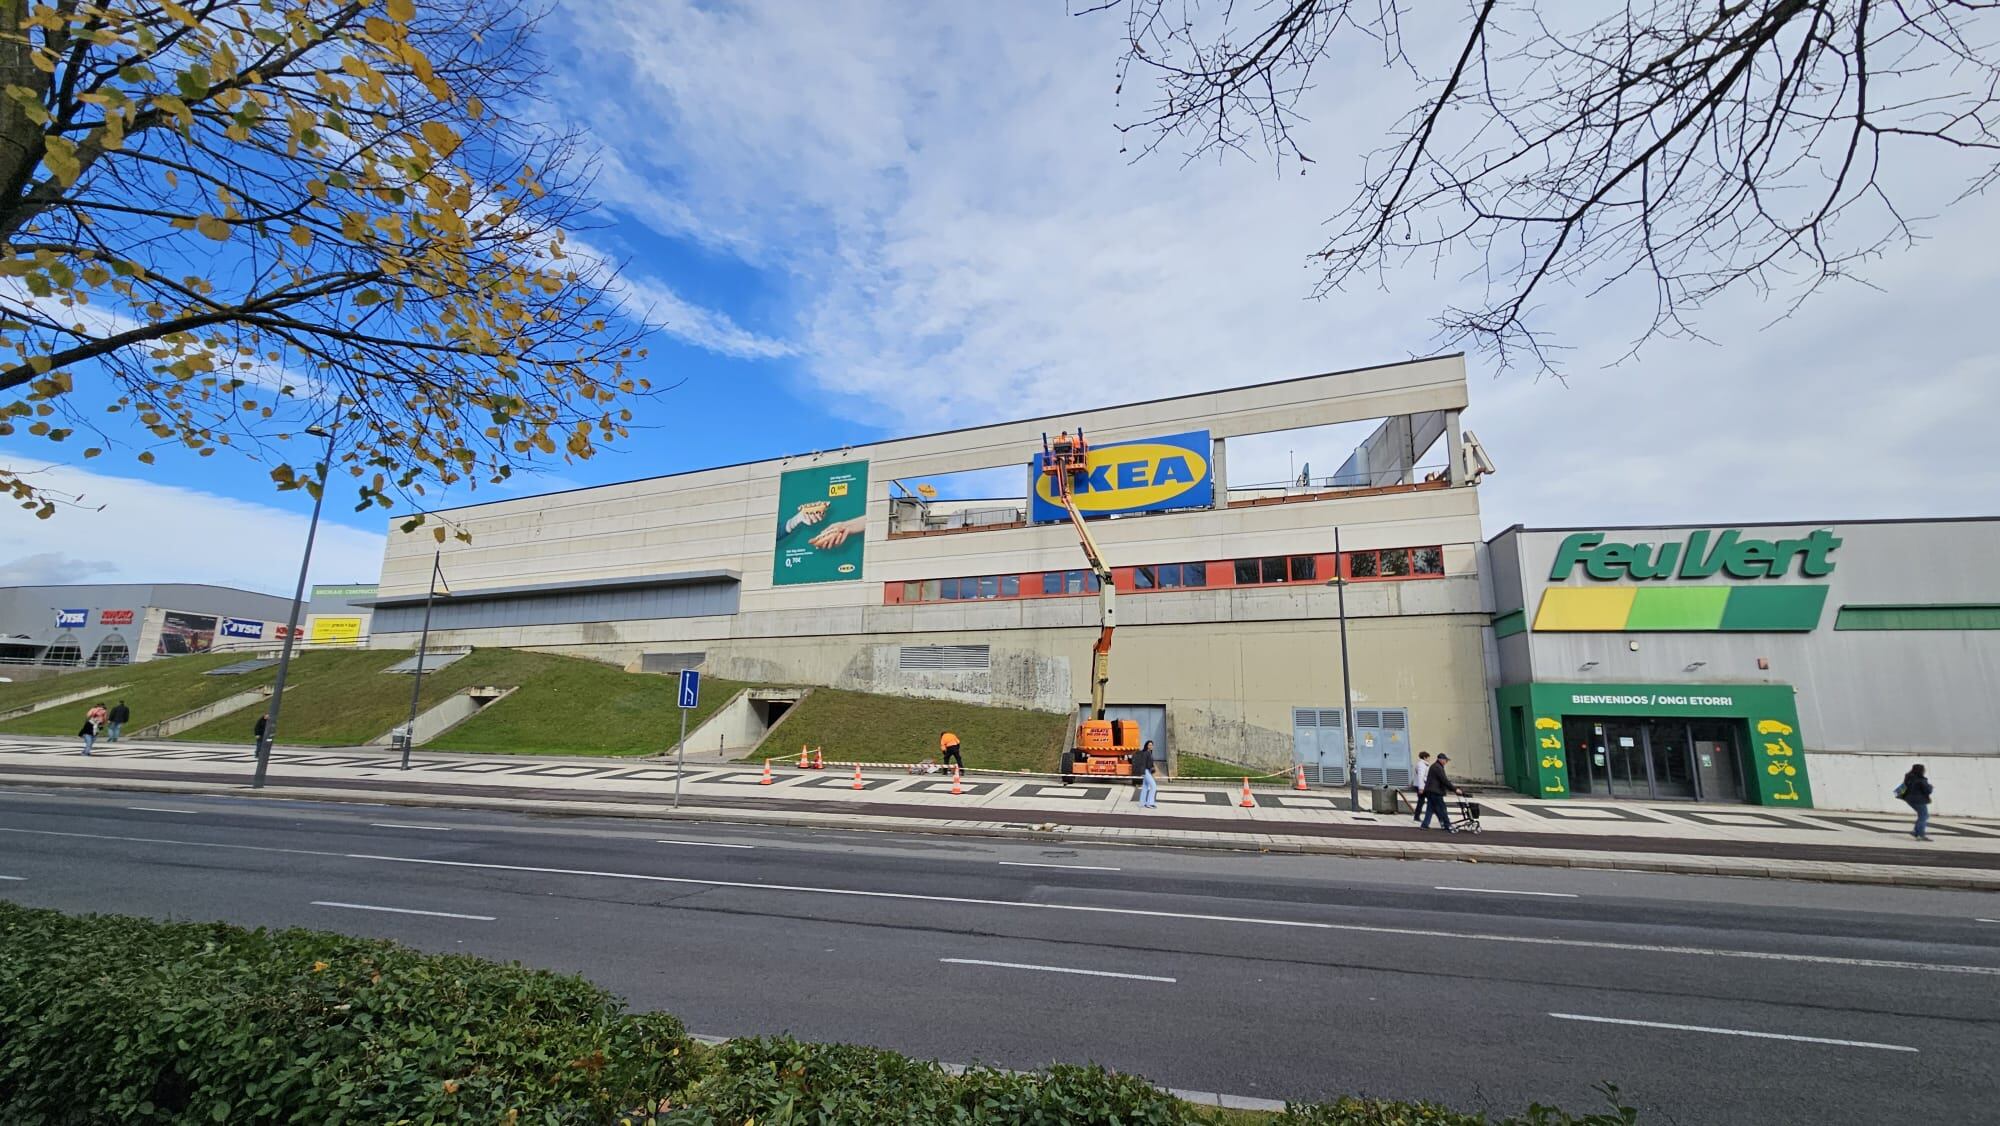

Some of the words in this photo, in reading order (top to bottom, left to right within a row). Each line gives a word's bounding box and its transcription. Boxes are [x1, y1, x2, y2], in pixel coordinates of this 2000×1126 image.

[229, 623, 262, 635] JYSK
[1572, 695, 1648, 704] BIENVENIDOS
[1658, 696, 1687, 705] ONGI
[1690, 697, 1733, 706] ETORRI
